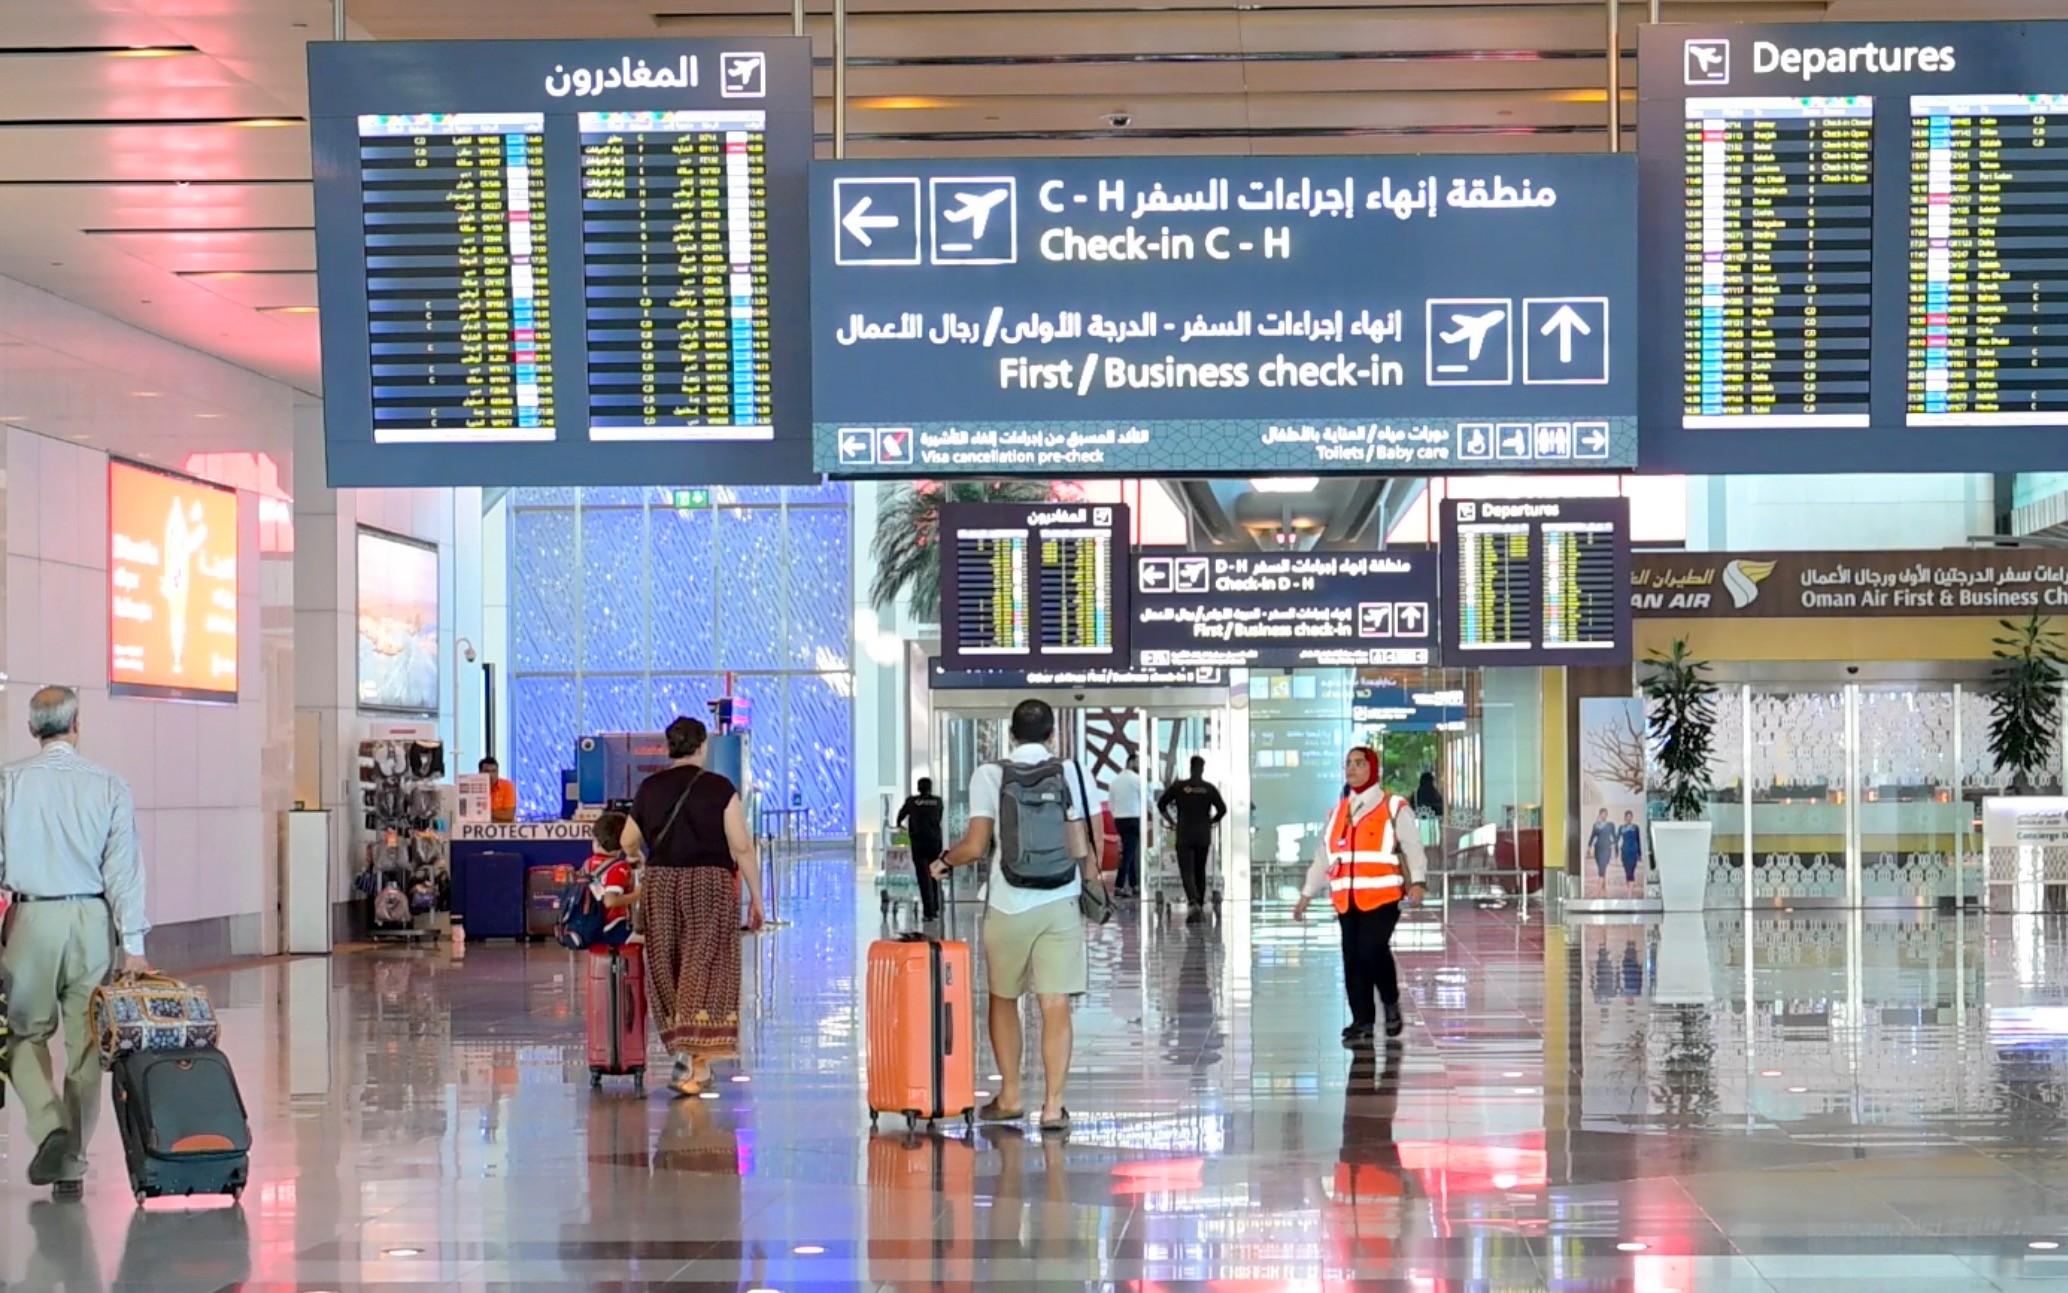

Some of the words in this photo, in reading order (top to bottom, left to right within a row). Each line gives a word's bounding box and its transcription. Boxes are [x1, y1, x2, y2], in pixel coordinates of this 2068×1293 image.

[1753, 41, 1957, 81] Departures
[546, 55, 698, 96] المغادرون
[1039, 179, 1065, 213] C
[1098, 179, 1125, 212] H
[1131, 178, 1229, 219] السفر
[1237, 177, 1354, 219] إجراءات
[1365, 175, 1437, 220] إنهاء
[1446, 174, 1557, 208] منطقة
[1040, 226, 1194, 261] Check-in
[1205, 226, 1231, 260] C
[1264, 226, 1290, 259] H
[836, 312, 923, 346] الأعمال
[1087, 311, 1157, 344] الدرجة
[1180, 310, 1252, 343] السفر
[1257, 310, 1343, 343] إجراءات
[1350, 309, 1402, 344] إنهاء
[1000, 357, 1073, 389] First
[1104, 356, 1249, 389] Business
[1258, 353, 1404, 387] check-in
[922, 451, 950, 464] Visa
[952, 450, 1034, 464] cancellation
[1038, 449, 1104, 466] pre-check
[1315, 445, 1365, 460] Toilets
[1376, 445, 1415, 463] Baby
[1416, 447, 1449, 460] care
[1026, 508, 1087, 526] المغادرون
[1482, 503, 1560, 519] Departures
[1216, 559, 1228, 573] D
[1236, 559, 1248, 572] H
[1801, 564, 1851, 586] الأعمال
[1855, 568, 1896, 587] ورجال
[1934, 567, 1994, 586] الدرجتين
[1997, 567, 2032, 586] سفر
[1215, 576, 1276, 592] Check-in
[1278, 576, 1291, 590] D
[1302, 576, 1314, 590] H
[1653, 568, 1715, 588] الطيران
[1630, 594, 1664, 608] AN
[1668, 593, 1712, 608] AIR
[1801, 590, 1855, 608] Oman
[1861, 588, 1890, 607] Air
[1894, 588, 1934, 607] First
[1940, 588, 1954, 607] &
[1960, 587, 2039, 606] Business
[2044, 585, 2068, 604] Ch
[1234, 622, 1292, 637] Business
[1294, 622, 1352, 637] check-in
[463, 824, 538, 839] PROTECT
[2016, 832, 2059, 842] Concierge
